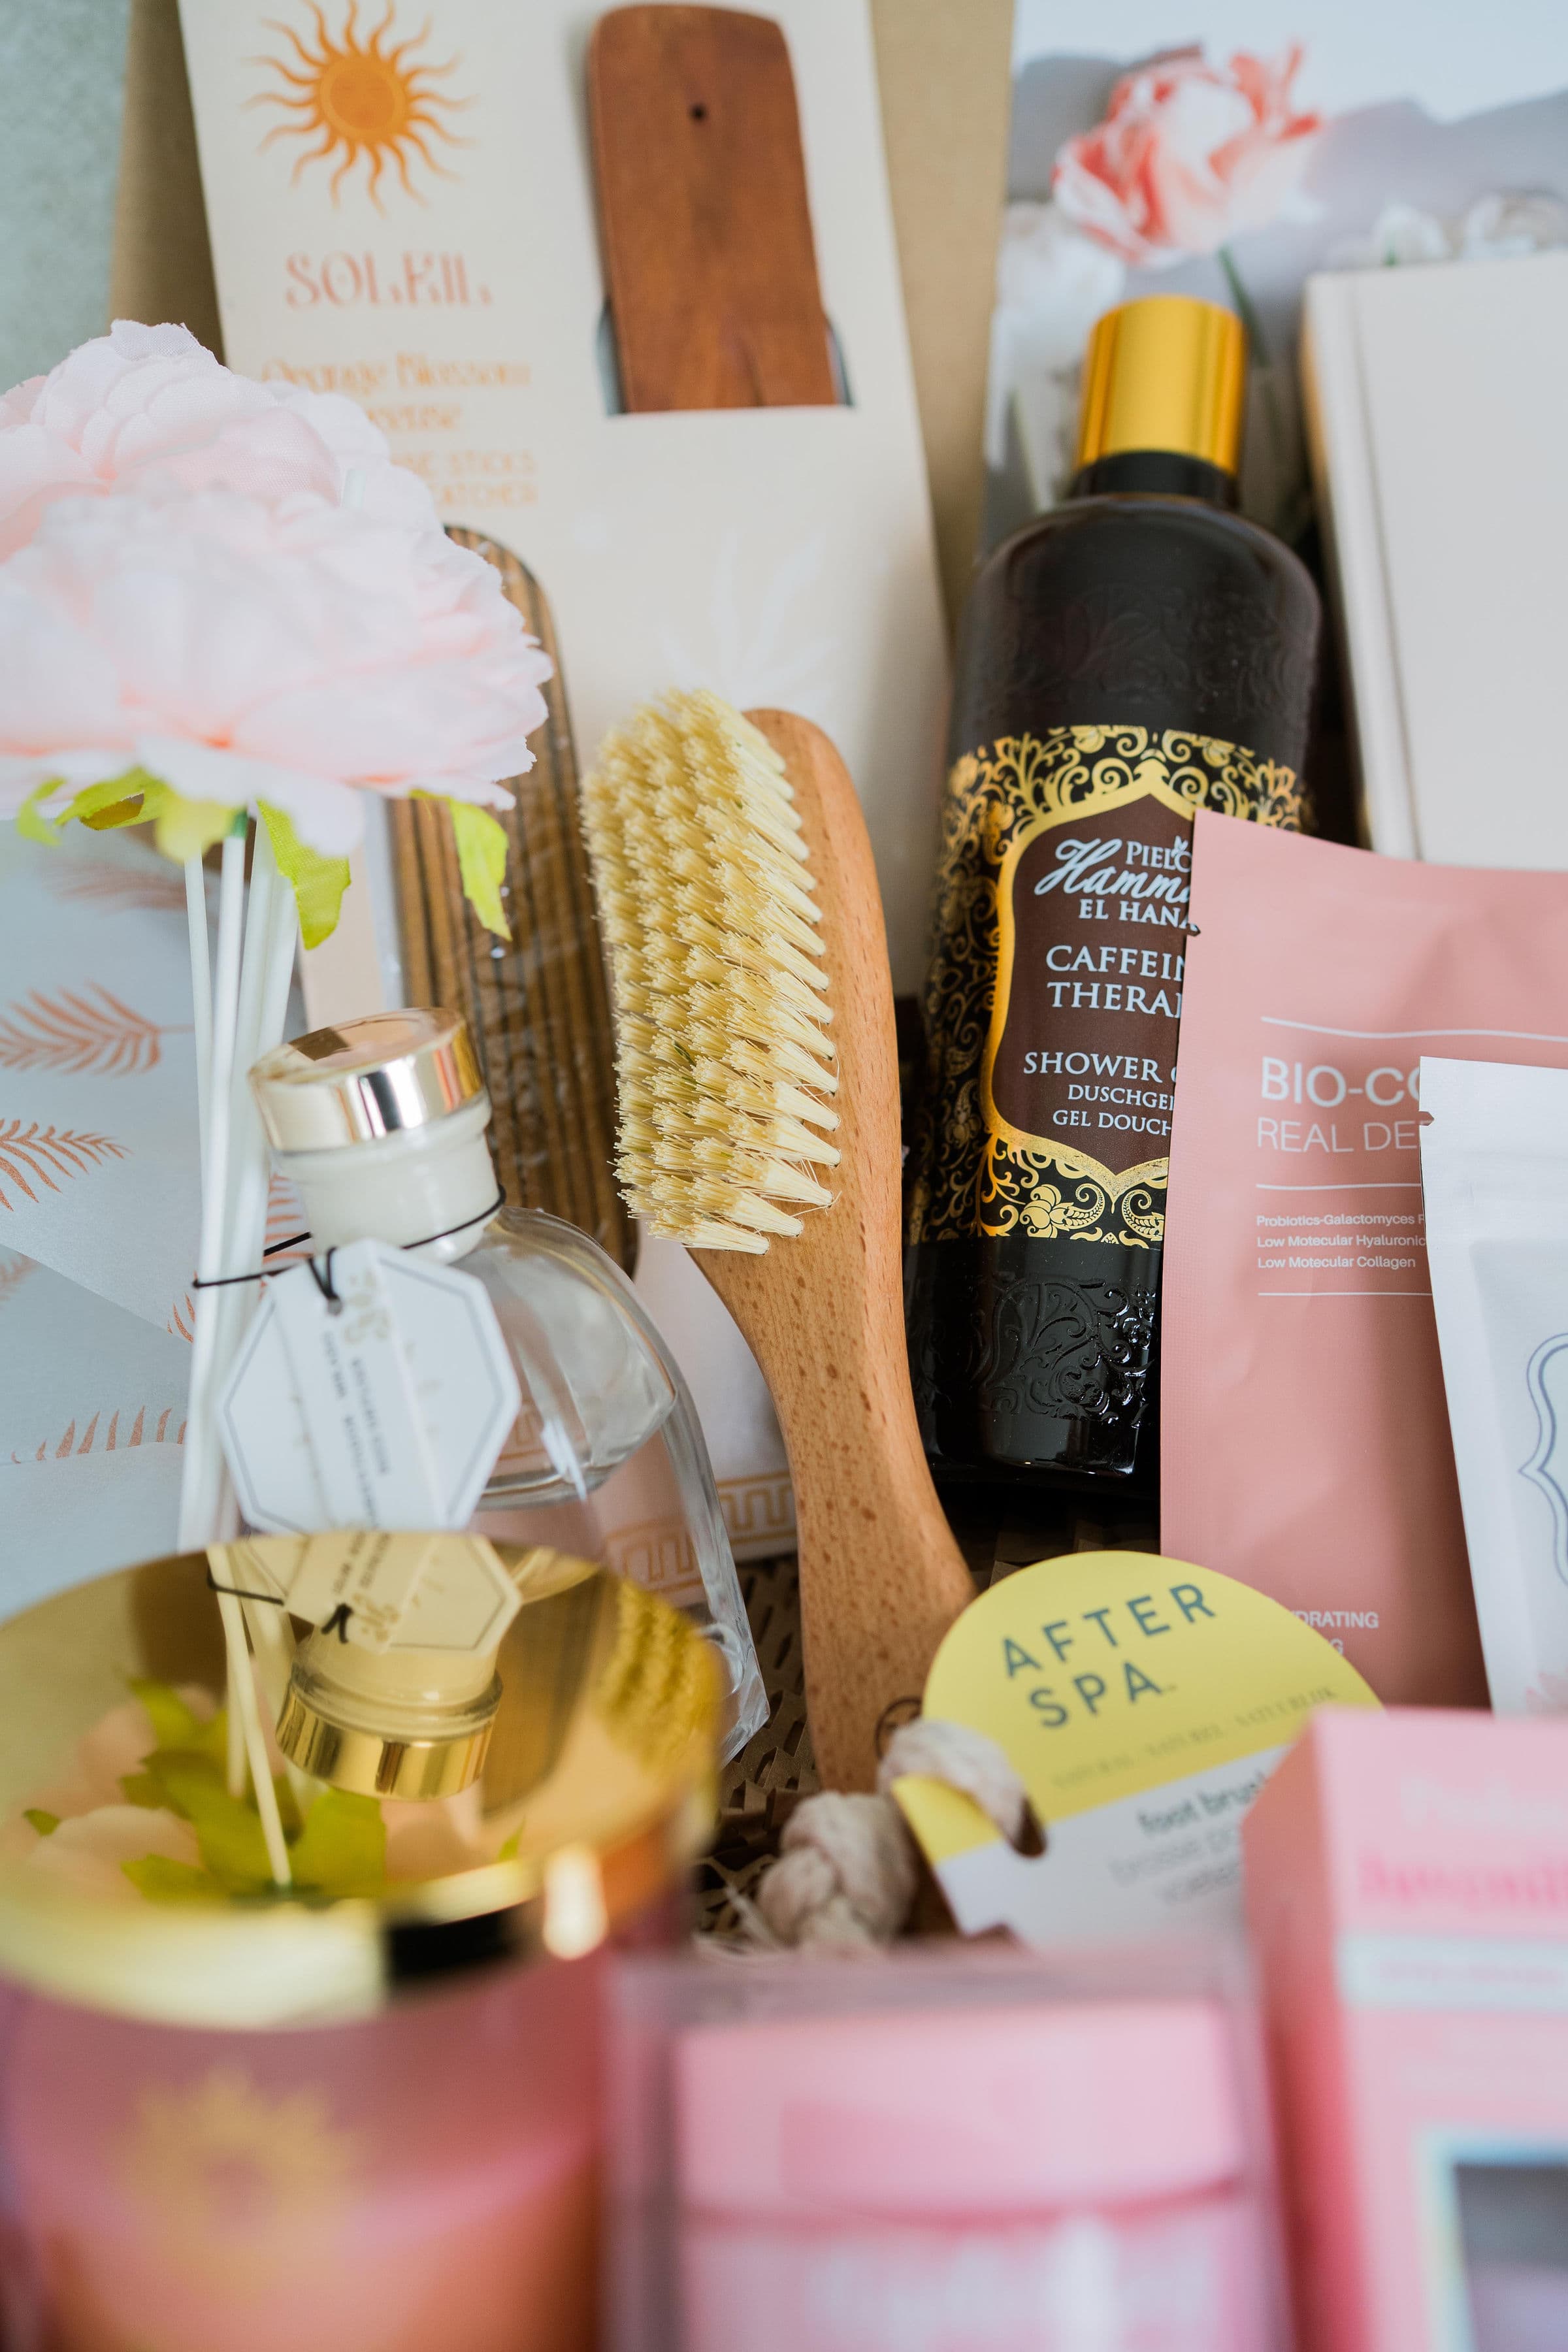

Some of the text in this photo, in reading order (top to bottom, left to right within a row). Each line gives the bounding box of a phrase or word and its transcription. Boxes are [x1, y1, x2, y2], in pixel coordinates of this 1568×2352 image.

[284, 251, 494, 309] SOLEIL
[1079, 898, 1109, 920] EL
[1023, 1051, 1163, 1083] SHOWER
[1052, 1109, 1091, 1127] GEL
[1256, 1117, 1433, 1153] REAL DE
[1256, 1213, 1416, 1227] Probiotics-Galactomyces
[1257, 1237, 1284, 1248] Low
[1356, 1233, 1427, 1249] Hyaluronic
[1258, 1256, 1286, 1269] Low
[1356, 1255, 1416, 1270] Collagen
[1291, 1610, 1380, 1629] DRATING
[1002, 1583, 1216, 1679] AFTER
